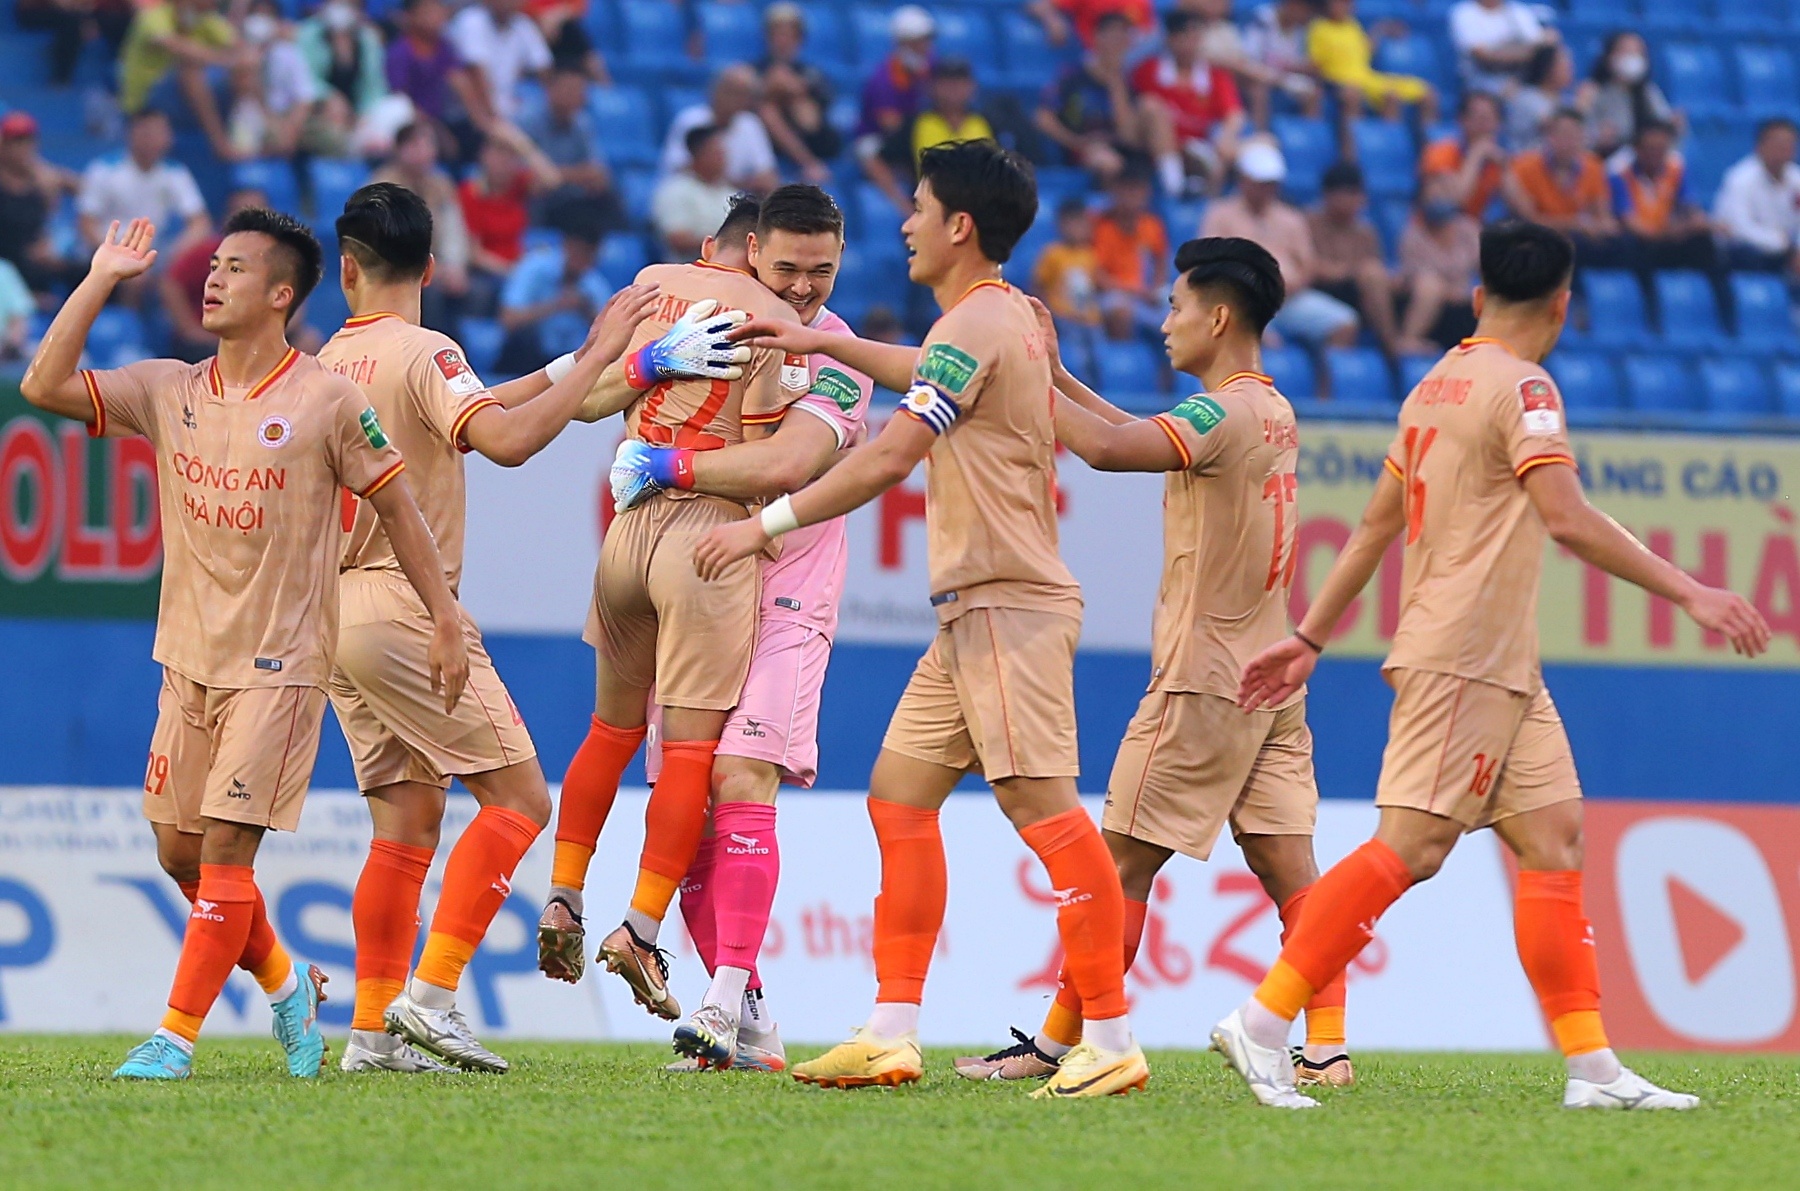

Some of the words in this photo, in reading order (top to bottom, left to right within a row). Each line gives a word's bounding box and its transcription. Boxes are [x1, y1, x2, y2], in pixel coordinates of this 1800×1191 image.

[173, 452, 239, 491] CÔNG
[245, 467, 286, 491] AN
[1681, 451, 1780, 502] CÁO
[184, 492, 210, 525] HÀ
[216, 500, 264, 536] NỘI
[144, 751, 169, 796] 29
[1469, 753, 1497, 798] 16
[726, 847, 770, 855] KAMITO
